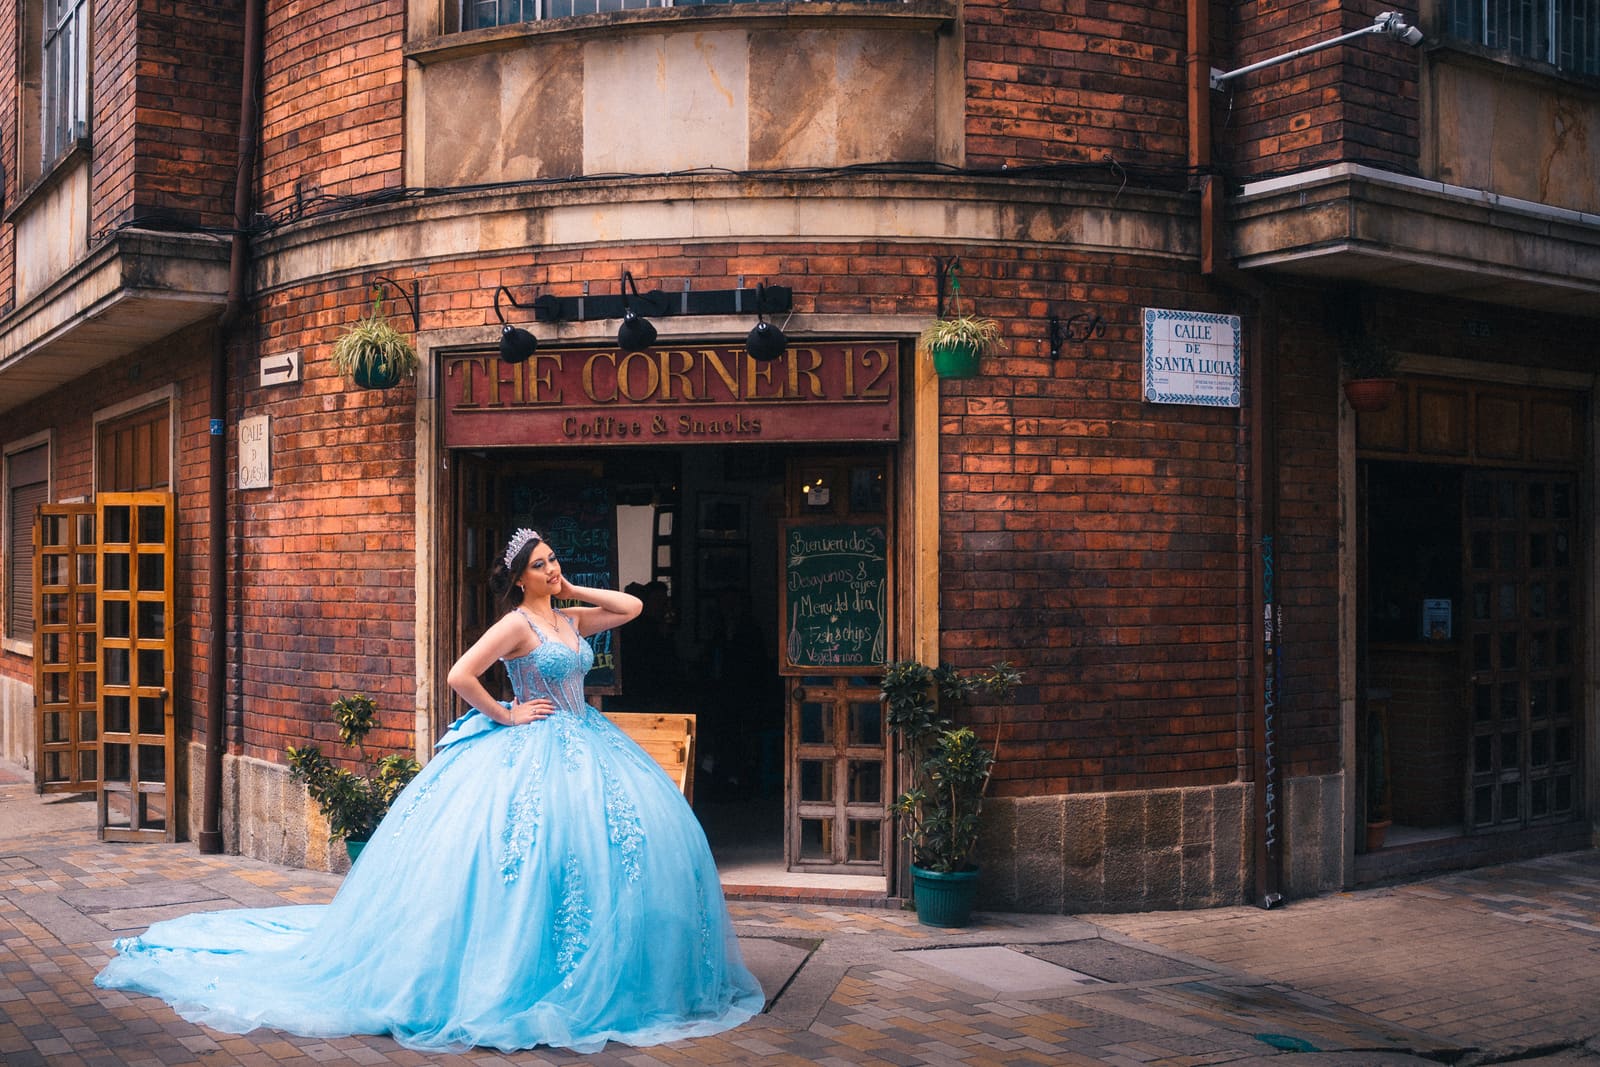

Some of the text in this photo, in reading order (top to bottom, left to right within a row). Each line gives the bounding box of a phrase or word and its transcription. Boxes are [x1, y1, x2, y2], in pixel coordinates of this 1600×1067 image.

[1174, 323, 1212, 340] CALLE
[1185, 343, 1201, 354] DE
[1154, 356, 1234, 375] SANTA LUCIA
[448, 348, 892, 408] THE CORNER 12
[562, 413, 763, 437] Coffee & Snacks
[790, 530, 876, 556] Bienvenidos
